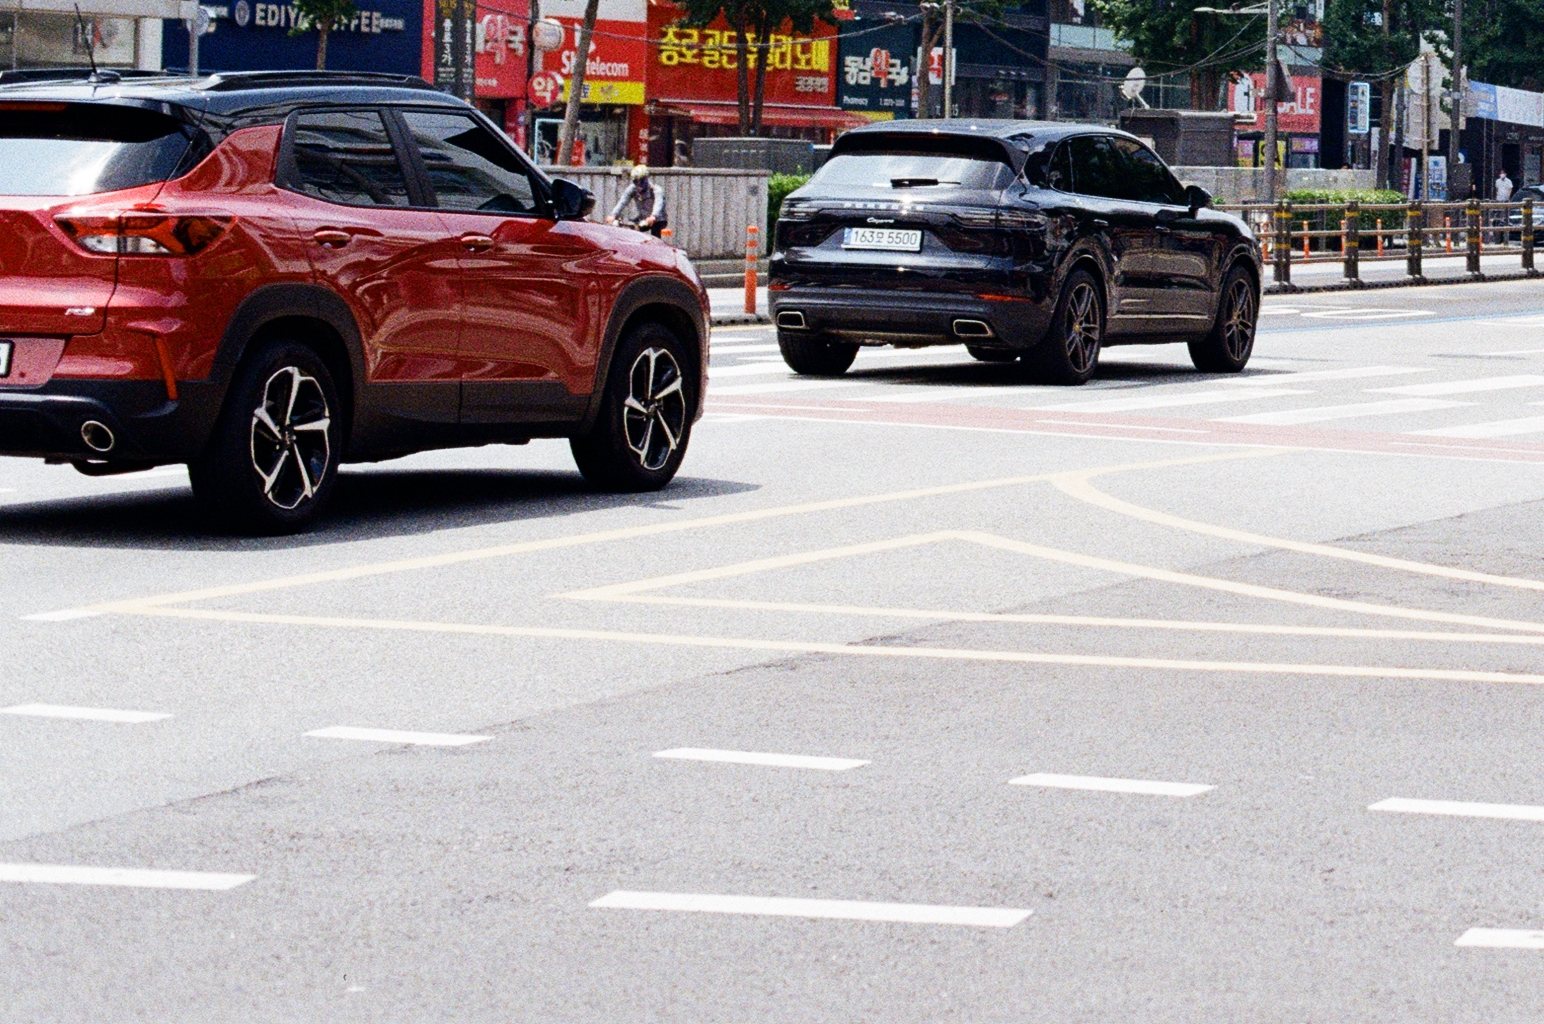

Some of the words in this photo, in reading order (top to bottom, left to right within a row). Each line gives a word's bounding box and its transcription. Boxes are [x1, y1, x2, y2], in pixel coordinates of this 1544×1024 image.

[586, 56, 629, 77] telecom
[533, 77, 554, 103] 약
[887, 231, 918, 246] 5500
